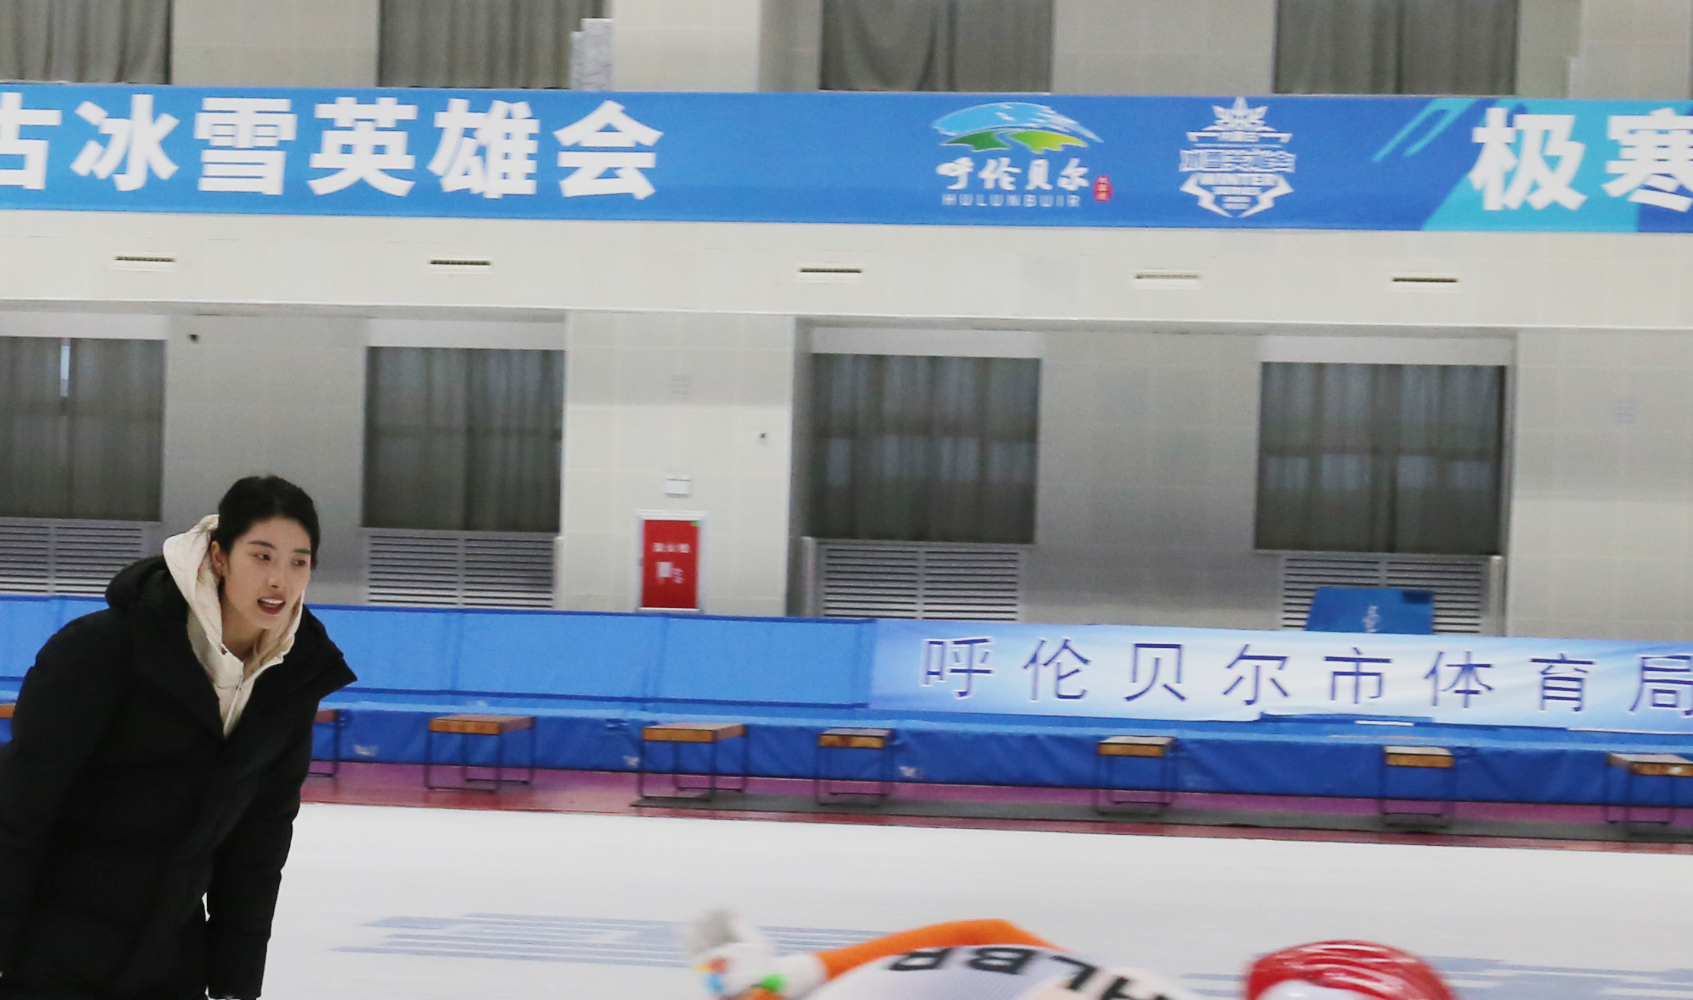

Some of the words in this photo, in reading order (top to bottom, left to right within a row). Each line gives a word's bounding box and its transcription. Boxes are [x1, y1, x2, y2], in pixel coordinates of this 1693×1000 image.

[920, 635, 1693, 717] 呼伦贝尔市体育局
